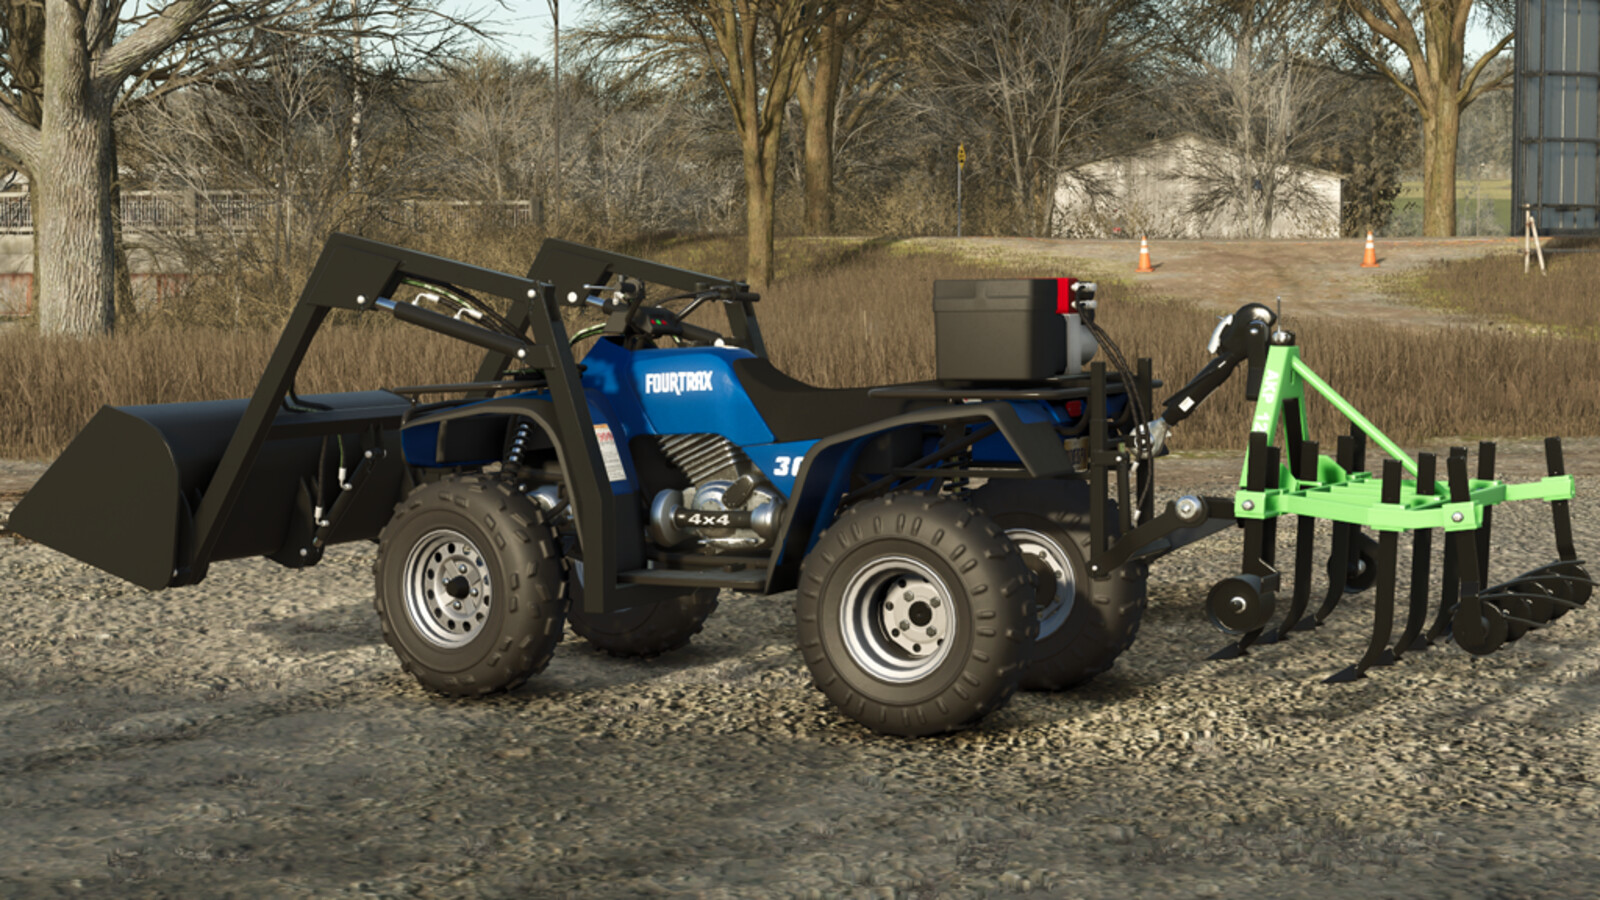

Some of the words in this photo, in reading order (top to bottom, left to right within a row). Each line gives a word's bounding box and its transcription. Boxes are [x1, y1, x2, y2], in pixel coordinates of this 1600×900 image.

[645, 370, 713, 396] FOURTRAX
[1262, 369, 1279, 403] AKP
[688, 513, 730, 526] 4x4
